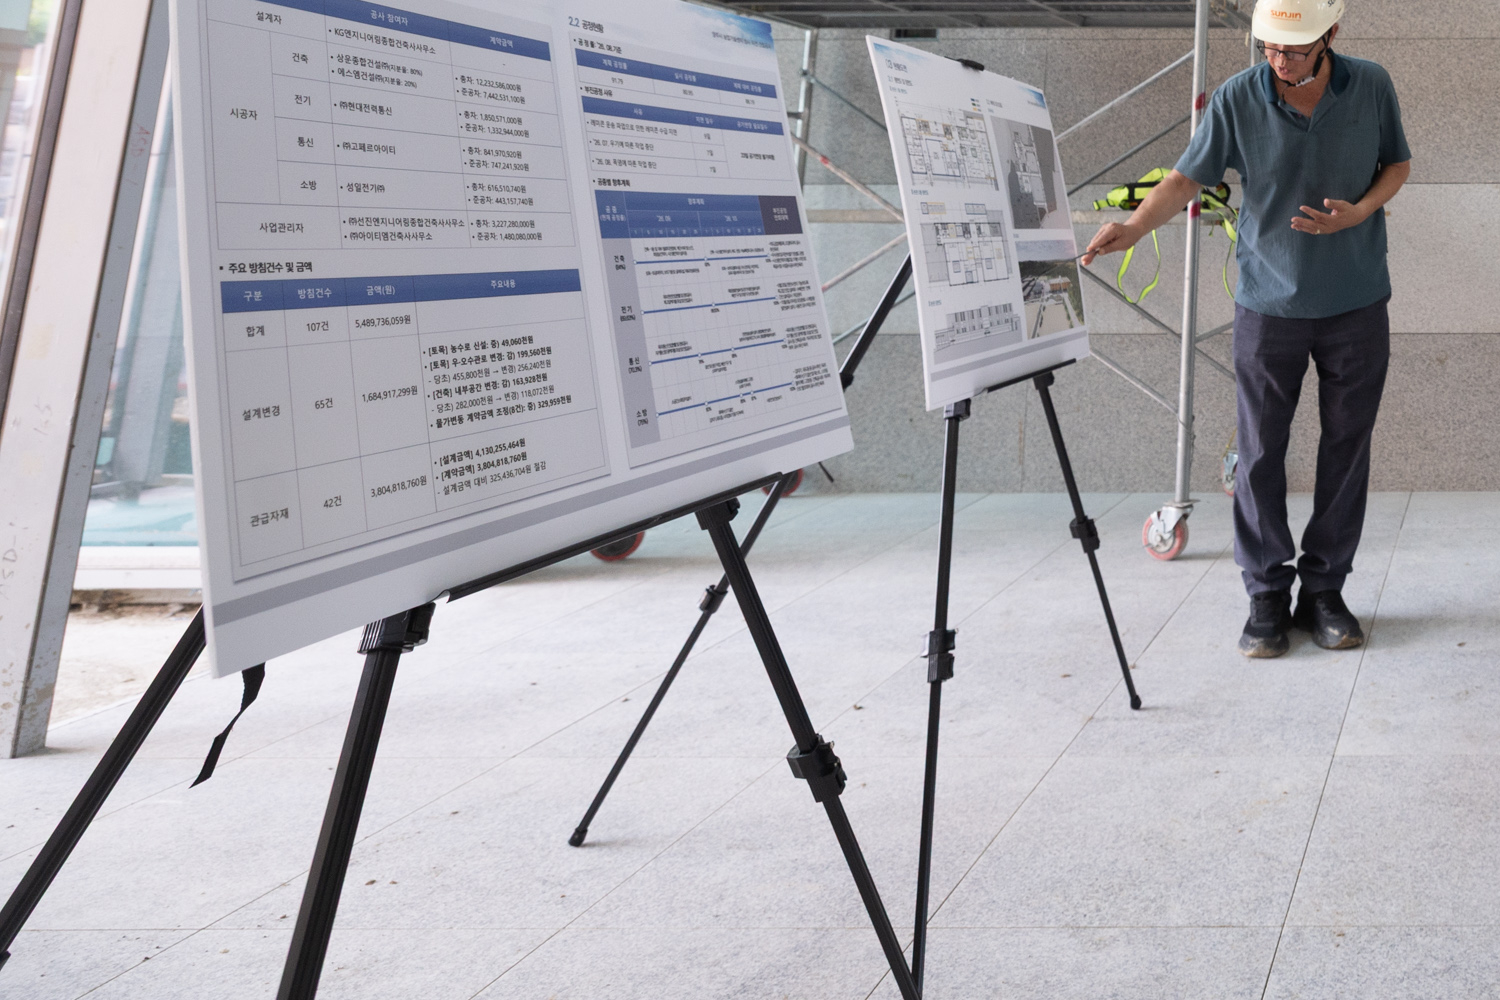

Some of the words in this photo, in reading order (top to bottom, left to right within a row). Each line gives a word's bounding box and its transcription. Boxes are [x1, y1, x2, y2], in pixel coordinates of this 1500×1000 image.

[256, 10, 282, 25] 설계자
[371, 10, 385, 21] 공사
[387, 14, 408, 26] 참여자
[568, 16, 580, 28] 2.2
[582, 20, 604, 34] 공정현황
[334, 28, 436, 55] KG엔지니어링종합건축사사무소
[490, 36, 514, 48] 계약금액
[292, 52, 308, 64] 건축
[460, 74, 474, 84] 총차:
[462, 87, 482, 98] 준공차:
[294, 94, 312, 106] 전기
[230, 108, 258, 120] 시공자
[464, 110, 479, 120] 총차:
[466, 123, 486, 134] 준공차:
[298, 136, 314, 148] 통신
[468, 146, 482, 156] 총차:
[469, 159, 490, 169] 준공차:
[300, 180, 318, 191] 소방
[472, 182, 487, 192] 총차:
[473, 196, 494, 204] 준공차:
[260, 222, 304, 234] 사업관리자
[476, 219, 491, 229] 총차:
[477, 232, 498, 242] 준공차:
[228, 262, 248, 274] 주요
[250, 262, 284, 274] 방침건수
[286, 262, 295, 272] 및
[296, 262, 313, 272] 금액
[366, 284, 396, 296] 금액(원)
[490, 280, 516, 289] 주요내용
[244, 290, 263, 302] 구분
[298, 288, 332, 300] 방침건수
[306, 320, 330, 332] 107건
[355, 314, 412, 329] 5,489,736,059원
[246, 325, 266, 338] 합계
[502, 336, 534, 348] 49,060천원
[517, 346, 552, 359] 199,560천원
[362, 386, 418, 404] 1,684,917,299원
[314, 398, 334, 410] 65건
[242, 406, 281, 422] 설계변경
[467, 409, 494, 422] 계약금액
[476, 438, 526, 457] 4,130,255,464원
[477, 452, 528, 472] 3,804,818,760원
[444, 479, 472, 496] 설계금액
[474, 476, 488, 487] 대비
[490, 465, 532, 484] 325,436,704원
[534, 460, 547, 472] 절감
[370, 476, 428, 498] 3,804,818,760원
[324, 496, 343, 509] 42건
[250, 508, 290, 528] 관급자재
